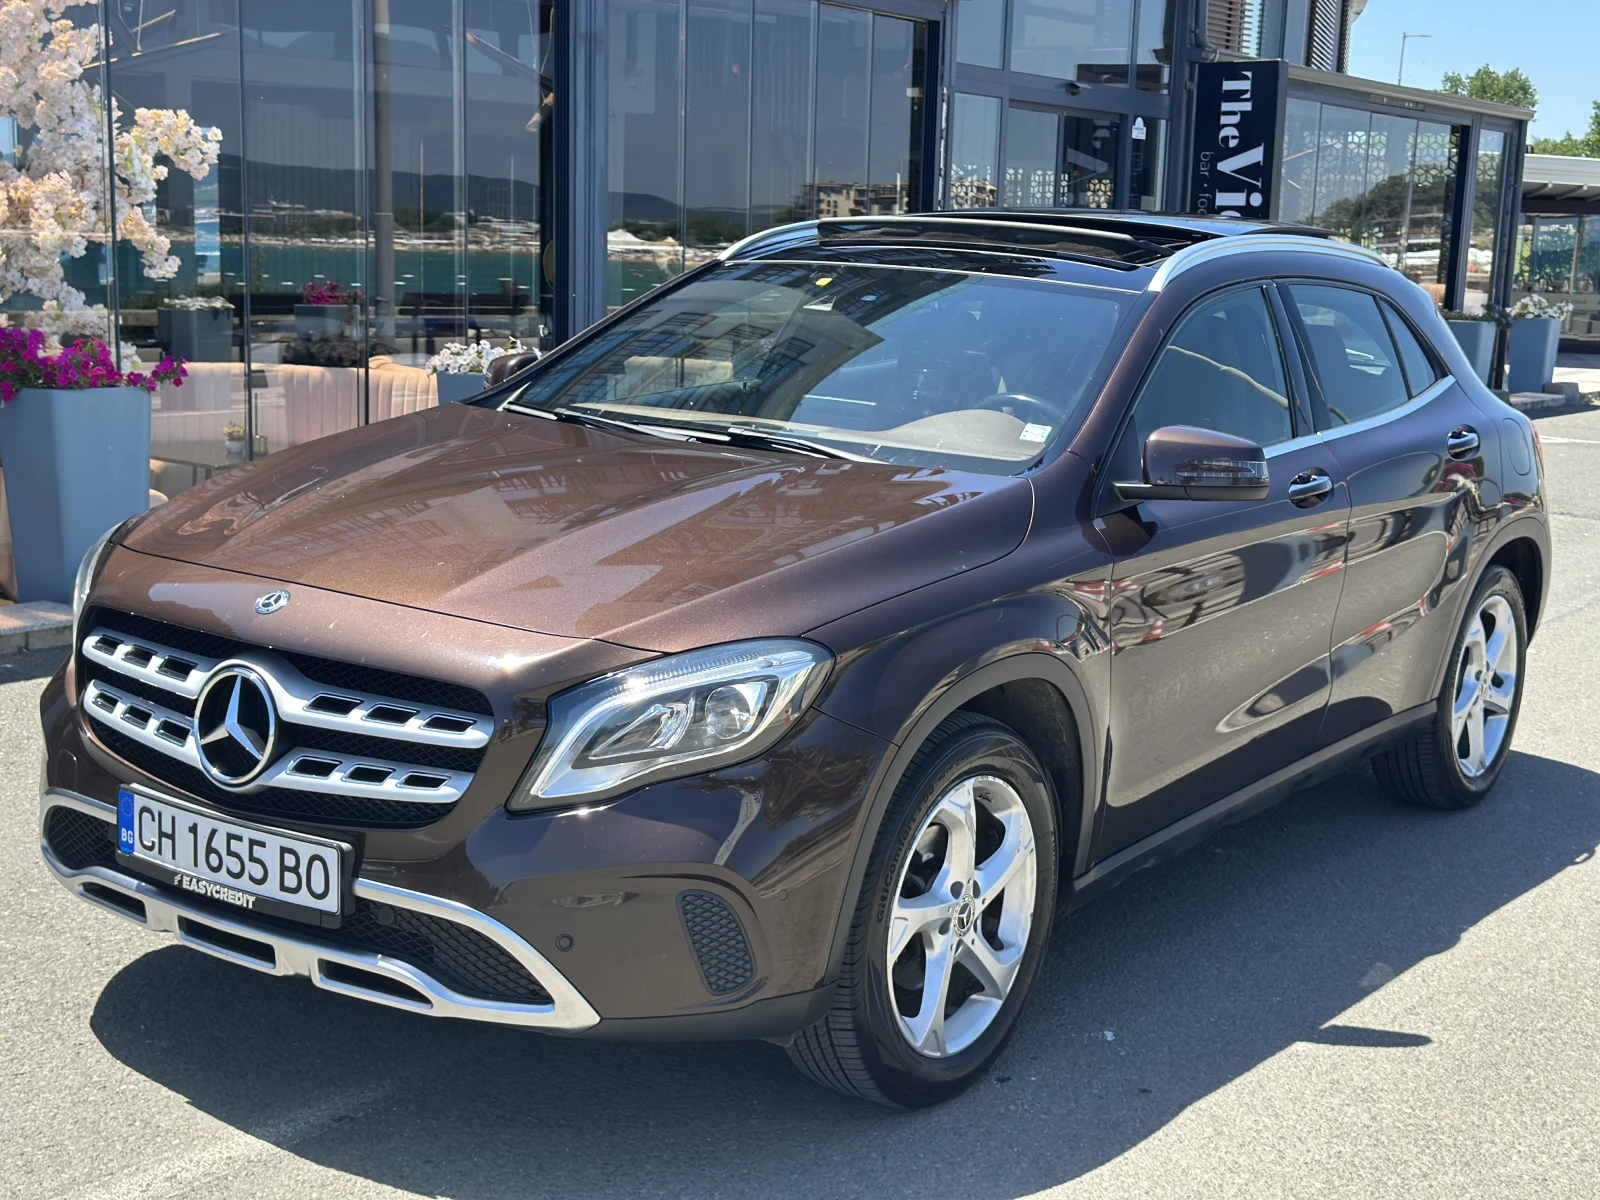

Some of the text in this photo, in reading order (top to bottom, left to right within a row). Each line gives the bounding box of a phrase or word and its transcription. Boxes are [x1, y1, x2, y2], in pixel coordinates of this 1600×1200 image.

[1215, 71, 1265, 218] The Vi
[1199, 151, 1214, 178] bar
[121, 827, 134, 845] BG
[138, 806, 330, 900] CH 1655 BO
[182, 875, 256, 909] EASYCREDIT
